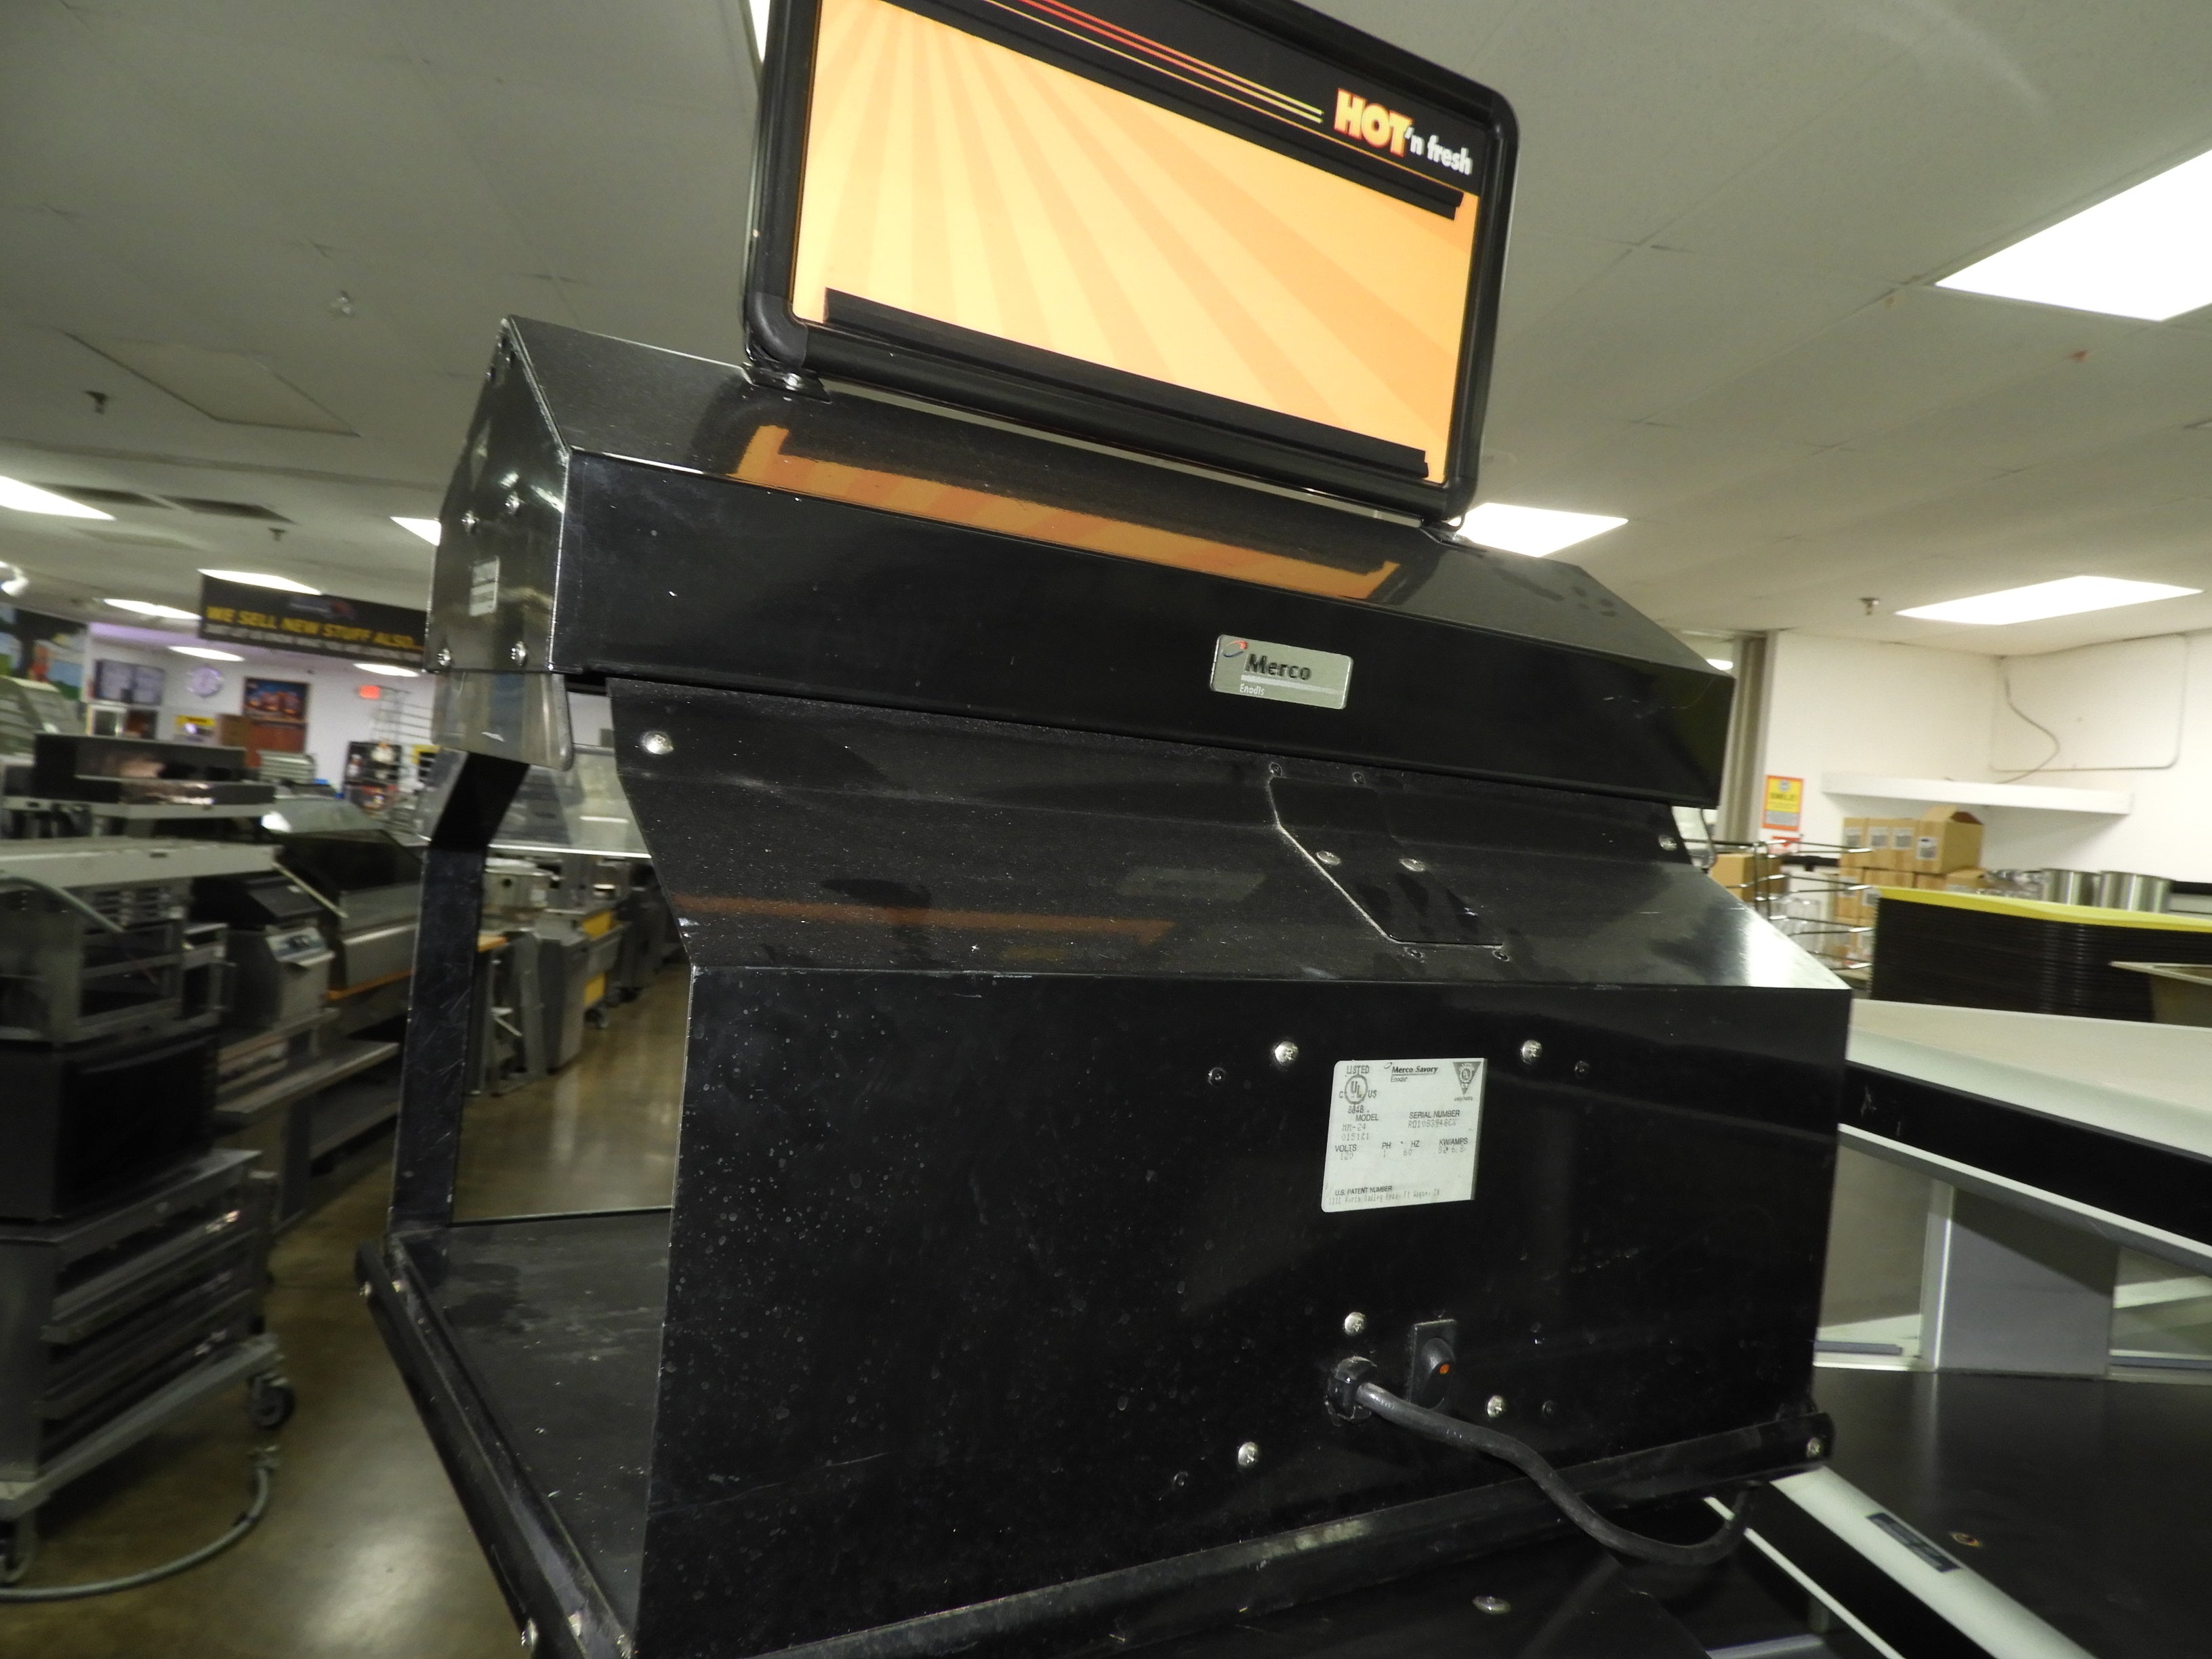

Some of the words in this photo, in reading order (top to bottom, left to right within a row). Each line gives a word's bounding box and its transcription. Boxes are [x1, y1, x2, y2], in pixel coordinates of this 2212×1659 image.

[1333, 88, 1414, 157] HOT
[1427, 135, 1473, 175] fresh
[206, 606, 235, 623] WE
[237, 609, 276, 629] SELL
[281, 617, 320, 635] NEW
[321, 622, 372, 640] STUFF
[1245, 653, 1312, 680] Merco
[1239, 683, 1265, 696] Enodis
[1347, 1065, 1370, 1074] LISTED
[1415, 1065, 1438, 1074] Savory
[1351, 1081, 1362, 1099] UL
[1368, 1090, 1377, 1099] US
[1355, 1113, 1378, 1122] MODEL
[1410, 1111, 1431, 1119] SERIAL
[1433, 1109, 1460, 1118] NUMBER
[1439, 1138, 1469, 1146] KW/AMPS
[1335, 1144, 1357, 1152] VOLTS
